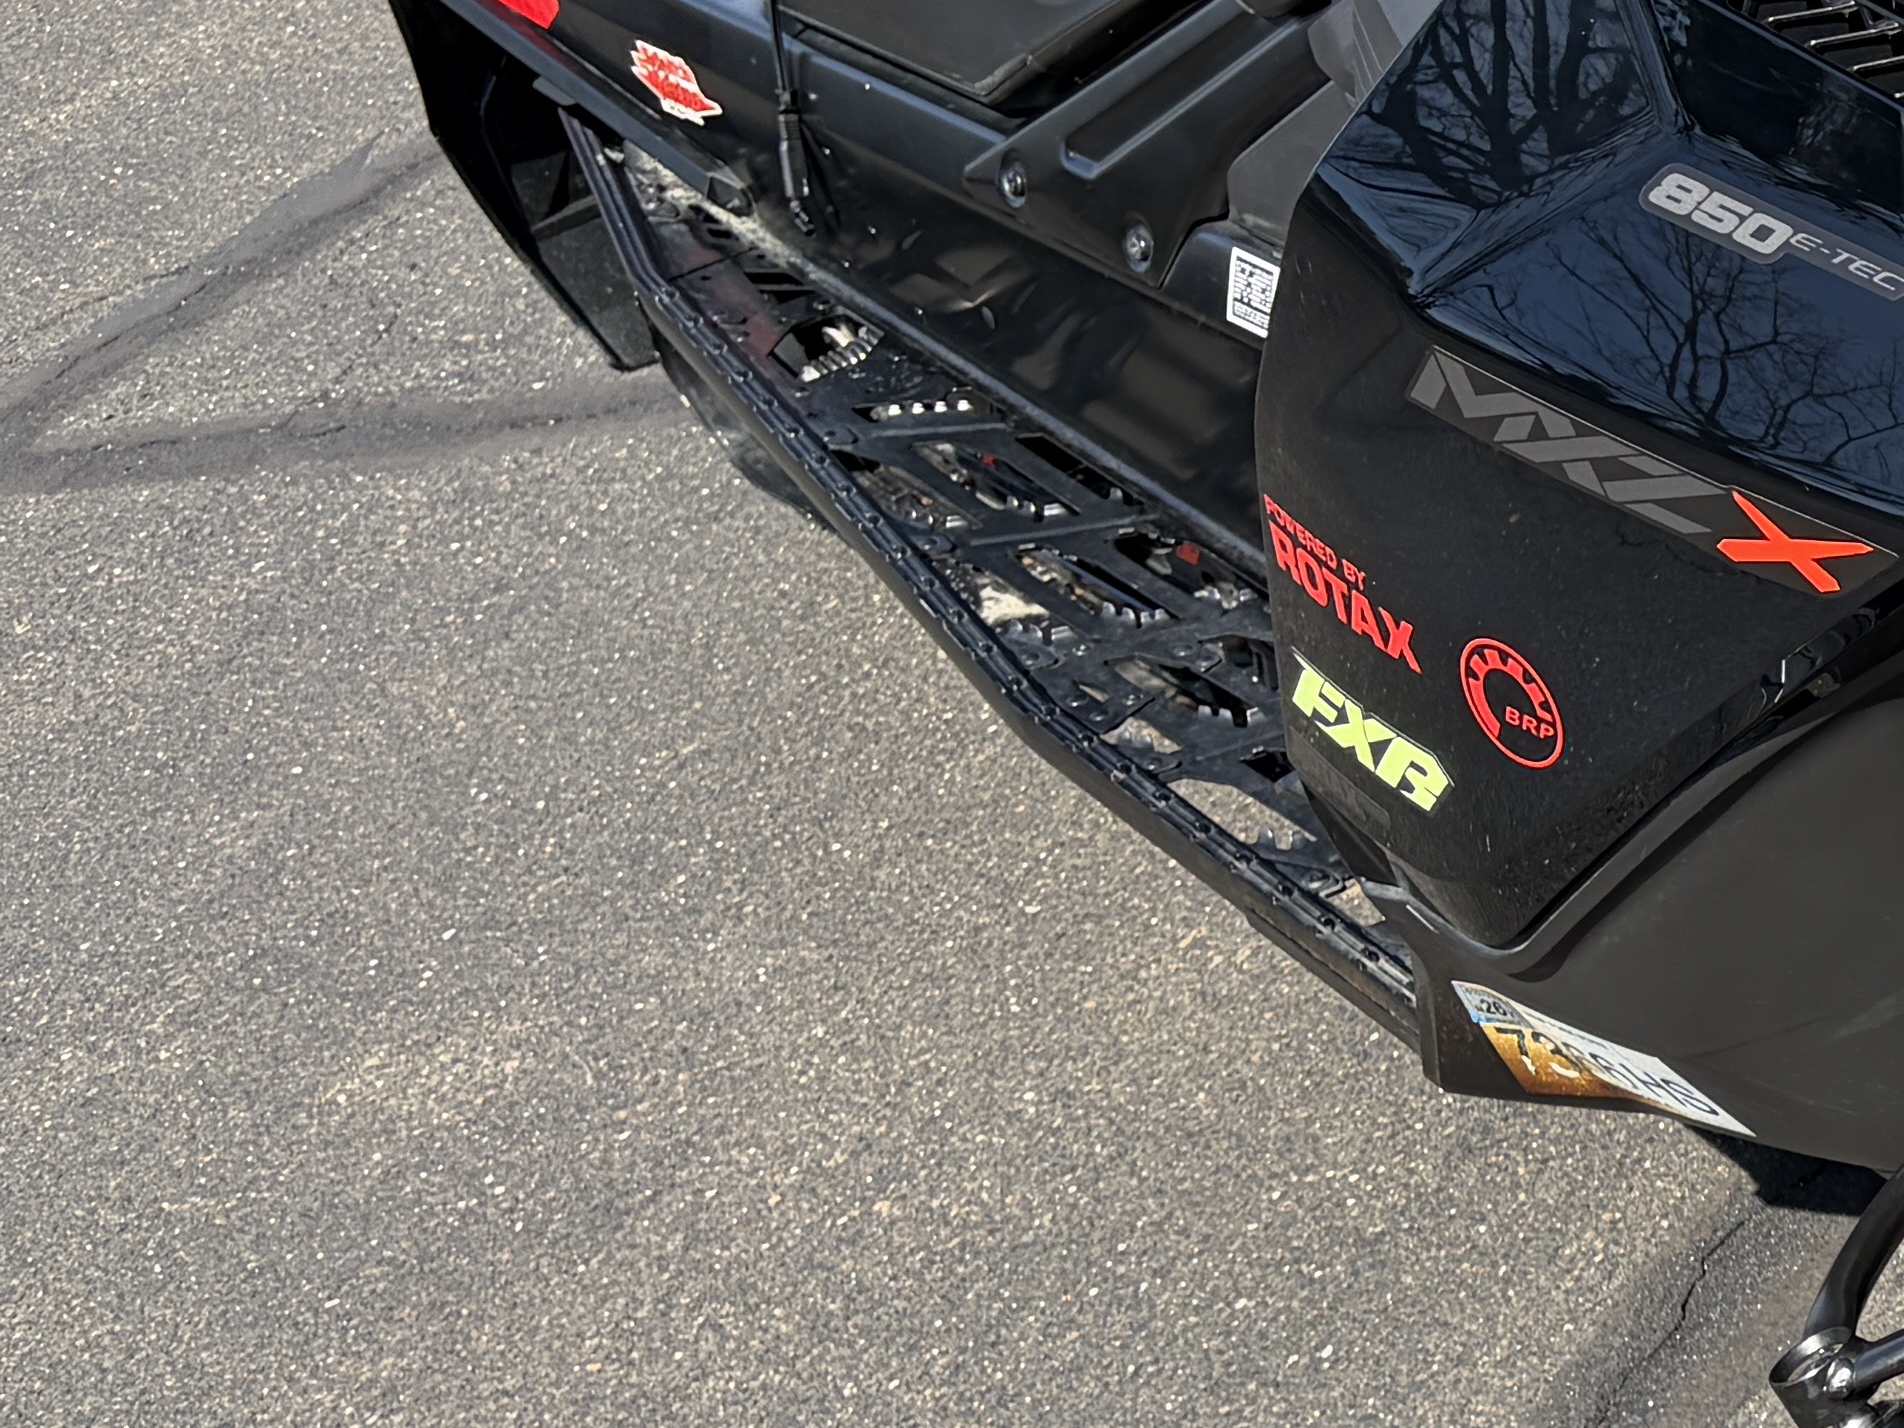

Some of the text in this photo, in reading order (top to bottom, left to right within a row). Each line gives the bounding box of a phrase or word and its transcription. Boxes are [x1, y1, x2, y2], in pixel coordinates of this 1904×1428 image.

[1646, 172, 1795, 256] 850
[1263, 493, 1367, 590] POWERED BY
[1716, 490, 1876, 594] X
[1268, 521, 1423, 675] ROTAX
[1291, 649, 1450, 813] FXR
[1504, 705, 1556, 740] BRP
